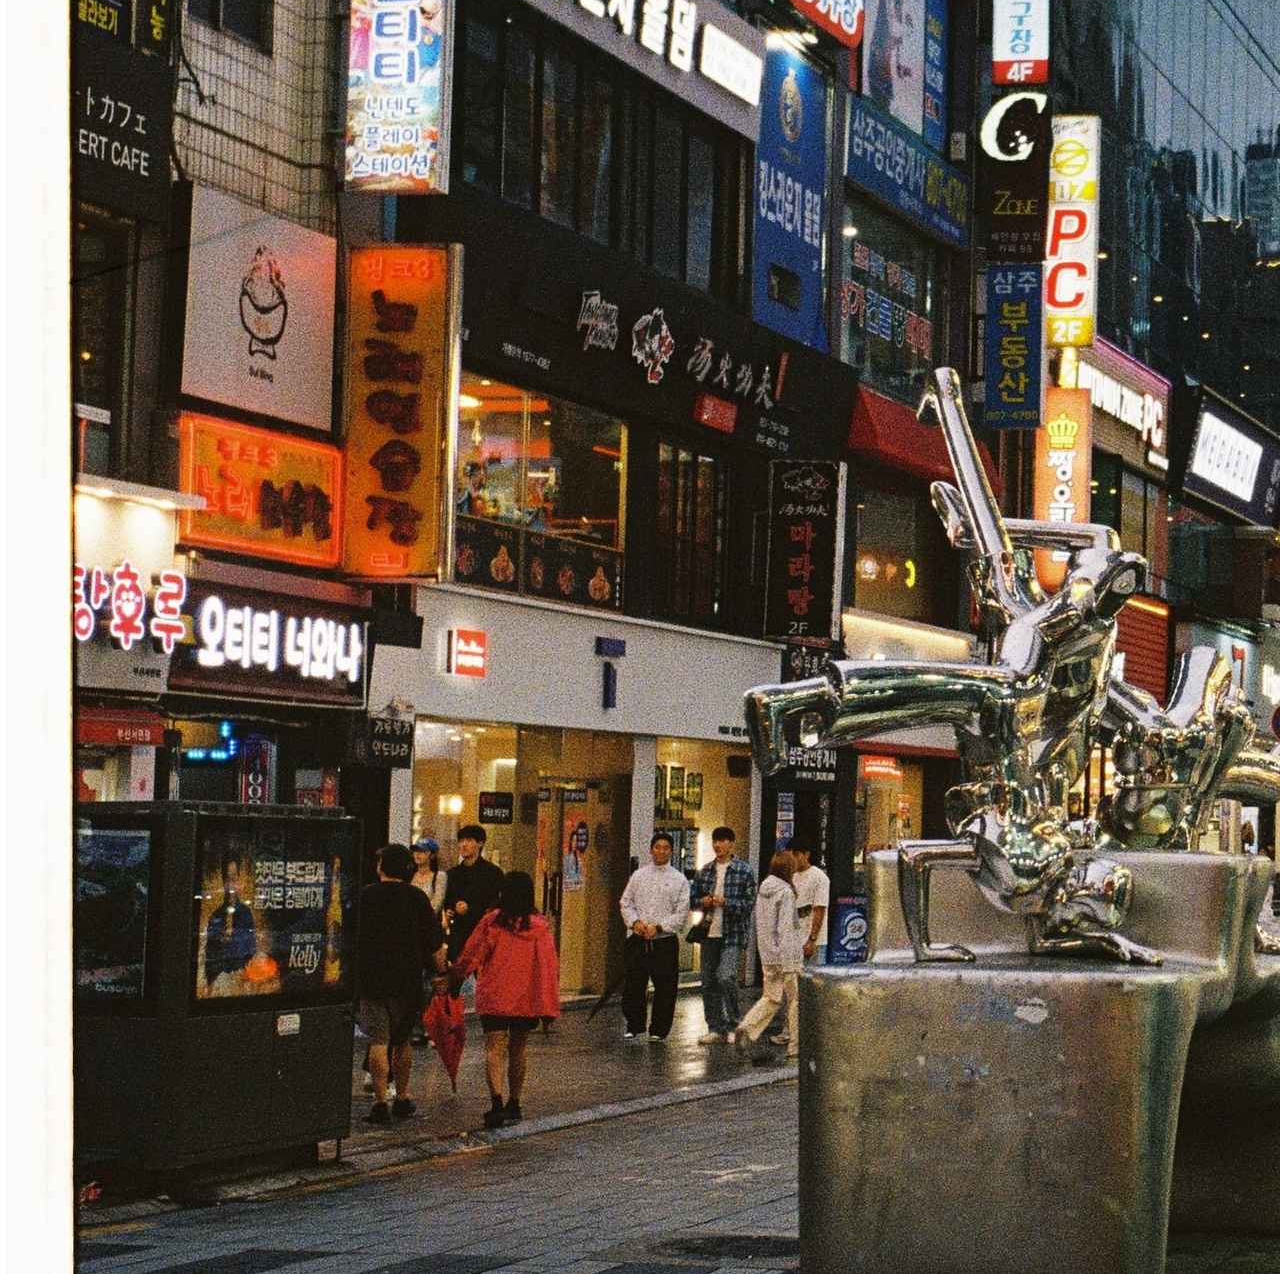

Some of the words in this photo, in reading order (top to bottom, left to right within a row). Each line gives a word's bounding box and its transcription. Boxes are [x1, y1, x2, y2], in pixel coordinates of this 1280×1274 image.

[1007, 62, 1034, 82] 4F
[366, 98, 421, 118] 닌텐도
[366, 129, 420, 149] 플레이
[78, 129, 108, 161] ERT
[111, 140, 150, 177] CAFE
[354, 154, 429, 175] 스테이션
[1047, 208, 1089, 313] PC
[993, 269, 1038, 294] 삼주
[1052, 321, 1082, 343] 2F
[999, 300, 1029, 403] 부동산
[788, 522, 814, 615] 마라탕
[198, 596, 279, 672] 오티티
[284, 616, 363, 683] 너와나
[788, 620, 809, 635] 2F
[289, 944, 322, 974] Kelly
